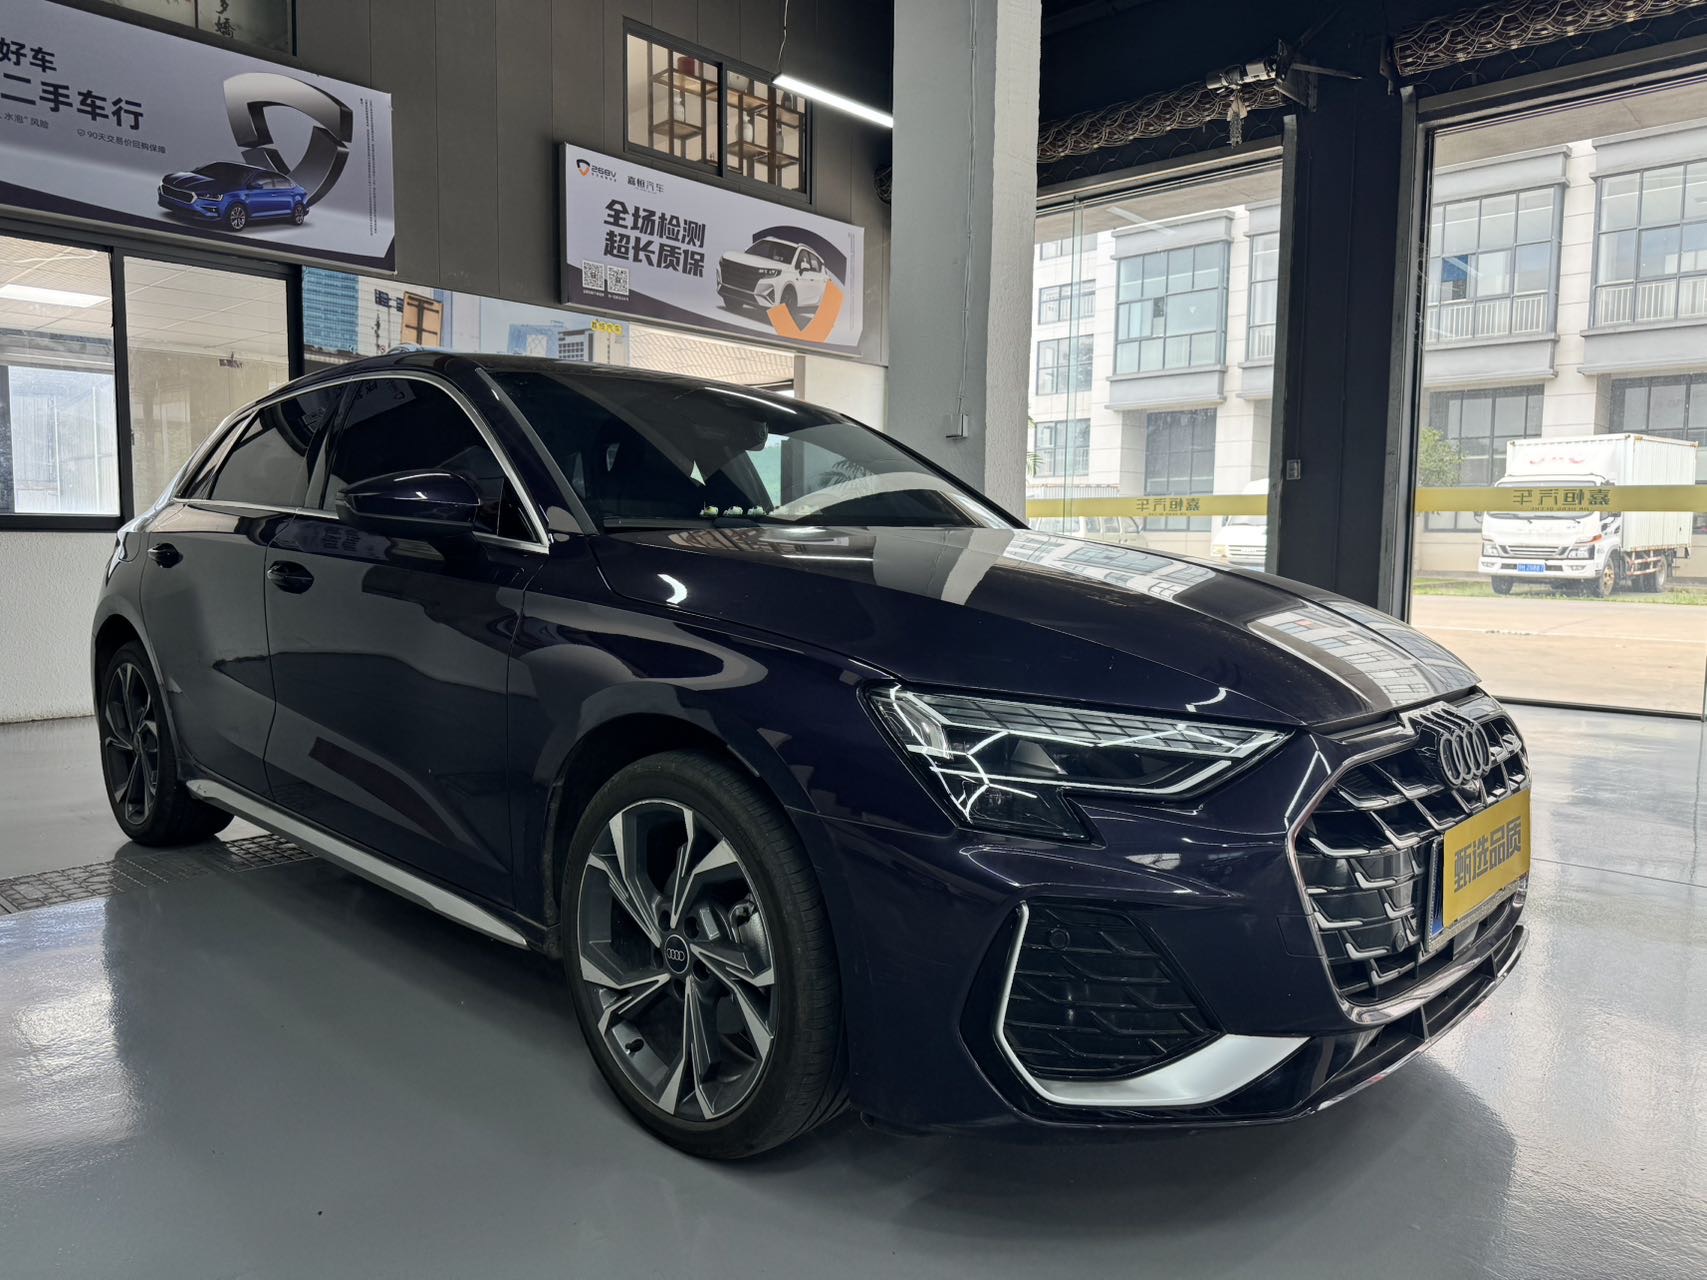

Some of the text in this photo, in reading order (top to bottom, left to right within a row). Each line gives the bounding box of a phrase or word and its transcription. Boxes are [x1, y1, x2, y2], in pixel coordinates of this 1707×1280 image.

[0, 72, 144, 131] 二手车行
[627, 175, 664, 193] 嘉恒汽车
[603, 199, 706, 249] 全场检测
[603, 229, 705, 278] 超长质保
[1454, 816, 1522, 893] 甄选品质
